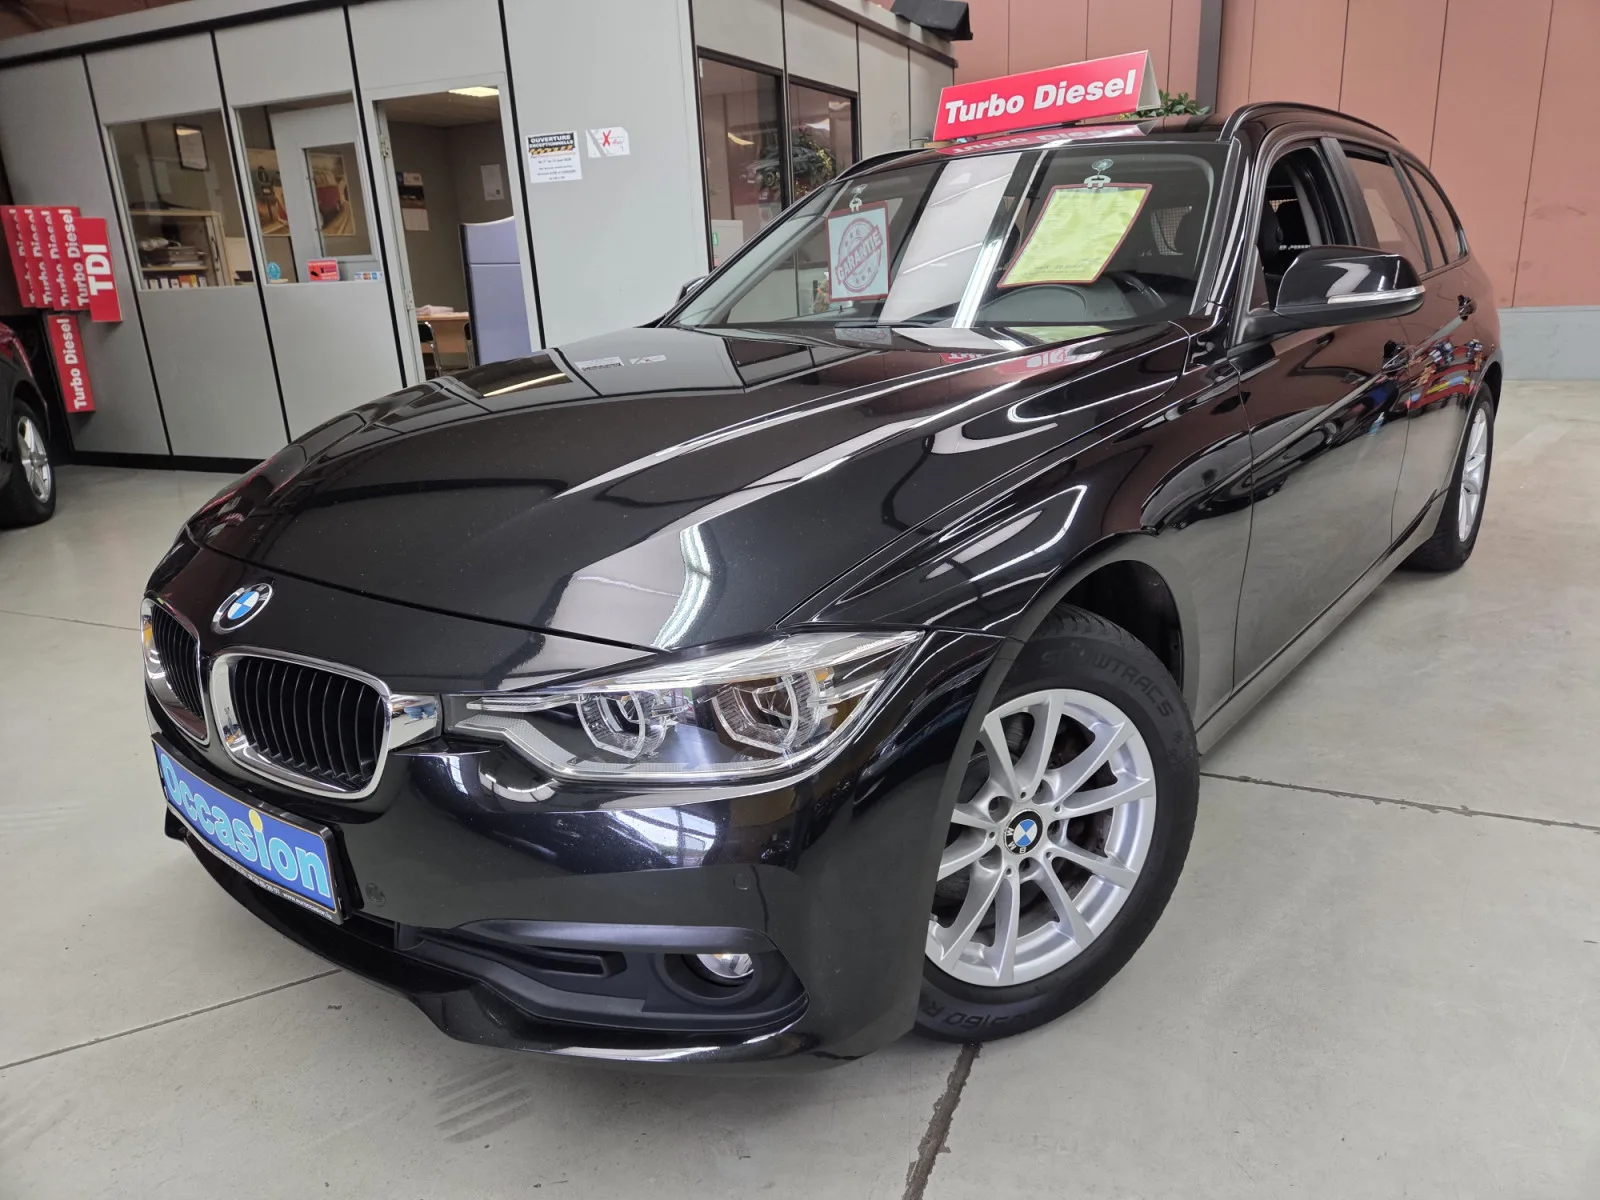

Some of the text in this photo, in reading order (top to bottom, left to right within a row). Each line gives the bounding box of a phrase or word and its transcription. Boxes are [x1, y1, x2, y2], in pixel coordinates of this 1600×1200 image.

[945, 69, 1136, 124] Turbo Diesel
[529, 134, 572, 144] OUVERTURE
[58, 209, 90, 306] Turbo Diesel
[82, 244, 114, 296] TDI
[837, 228, 882, 281] GARANTIE
[56, 318, 87, 409] Turbo Diesel
[161, 753, 331, 898] Occasion
[1006, 827, 1027, 854] BMW
